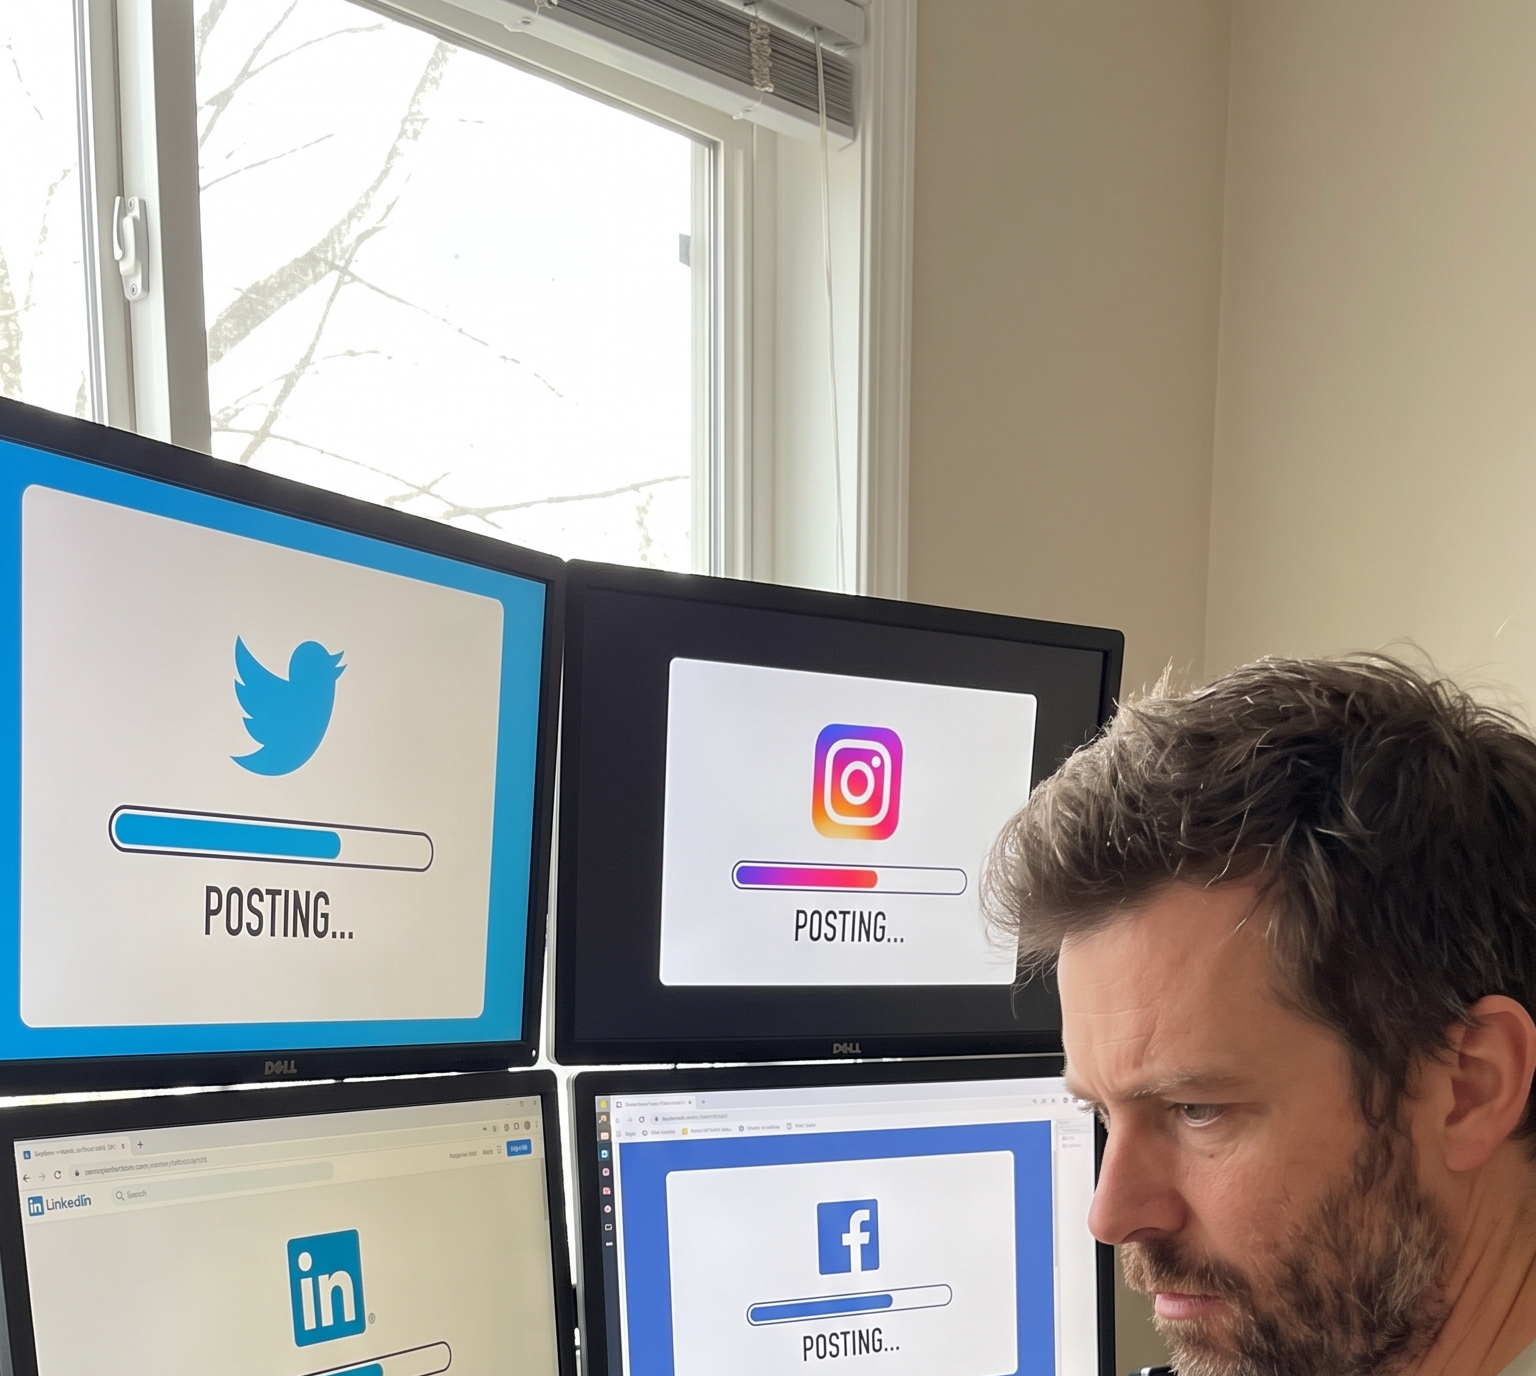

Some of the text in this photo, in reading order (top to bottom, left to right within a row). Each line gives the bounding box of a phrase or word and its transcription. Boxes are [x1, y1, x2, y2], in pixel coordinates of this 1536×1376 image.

[205, 885, 353, 939] POSTING...
[794, 909, 904, 942] POSTING...
[832, 1042, 862, 1055] DELL
[264, 1060, 298, 1075] DELL
[298, 1251, 356, 1331] in
[803, 1327, 900, 1362] POSTING...
